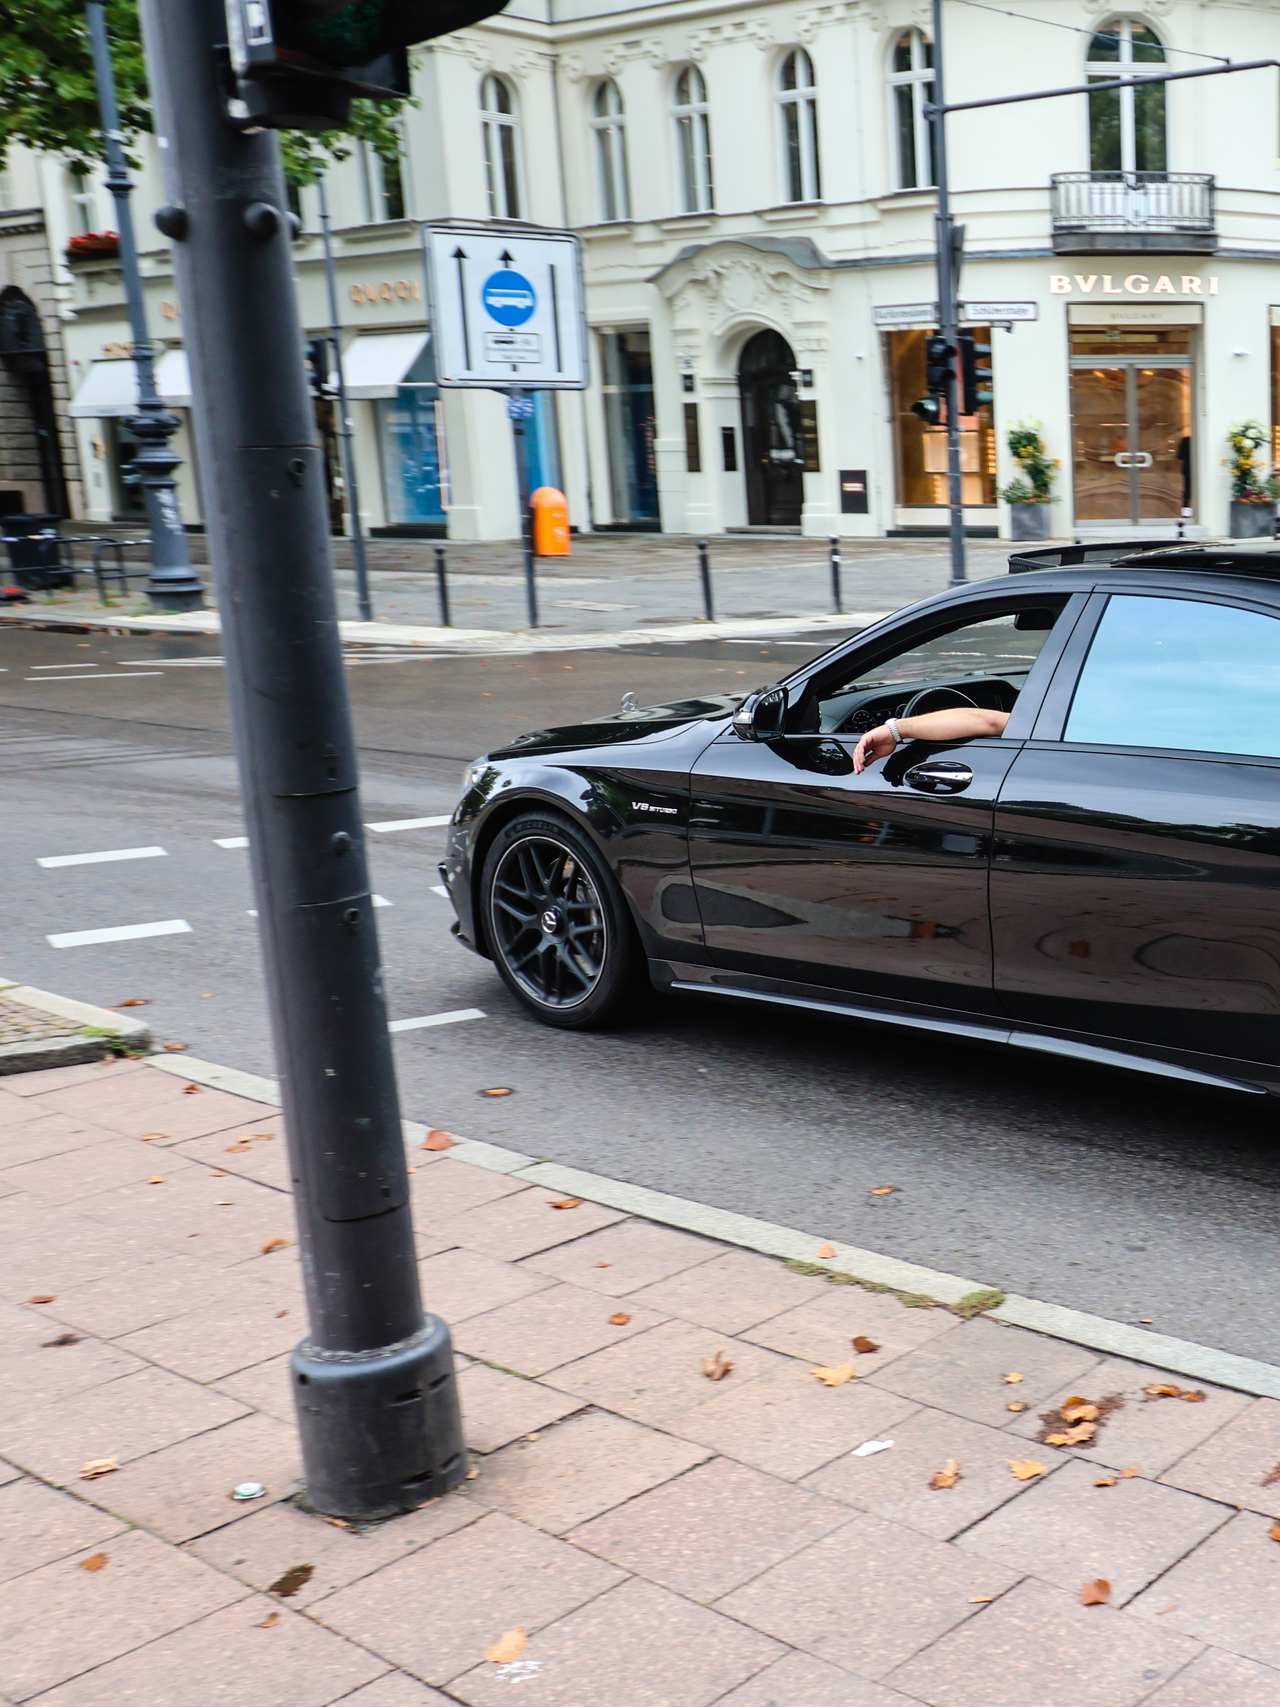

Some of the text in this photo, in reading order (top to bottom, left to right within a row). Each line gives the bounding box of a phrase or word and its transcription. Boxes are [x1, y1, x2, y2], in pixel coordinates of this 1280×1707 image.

[349, 280, 420, 305] GUCCI
[1049, 274, 1219, 296] BVLGARI
[631, 801, 650, 811] V8
